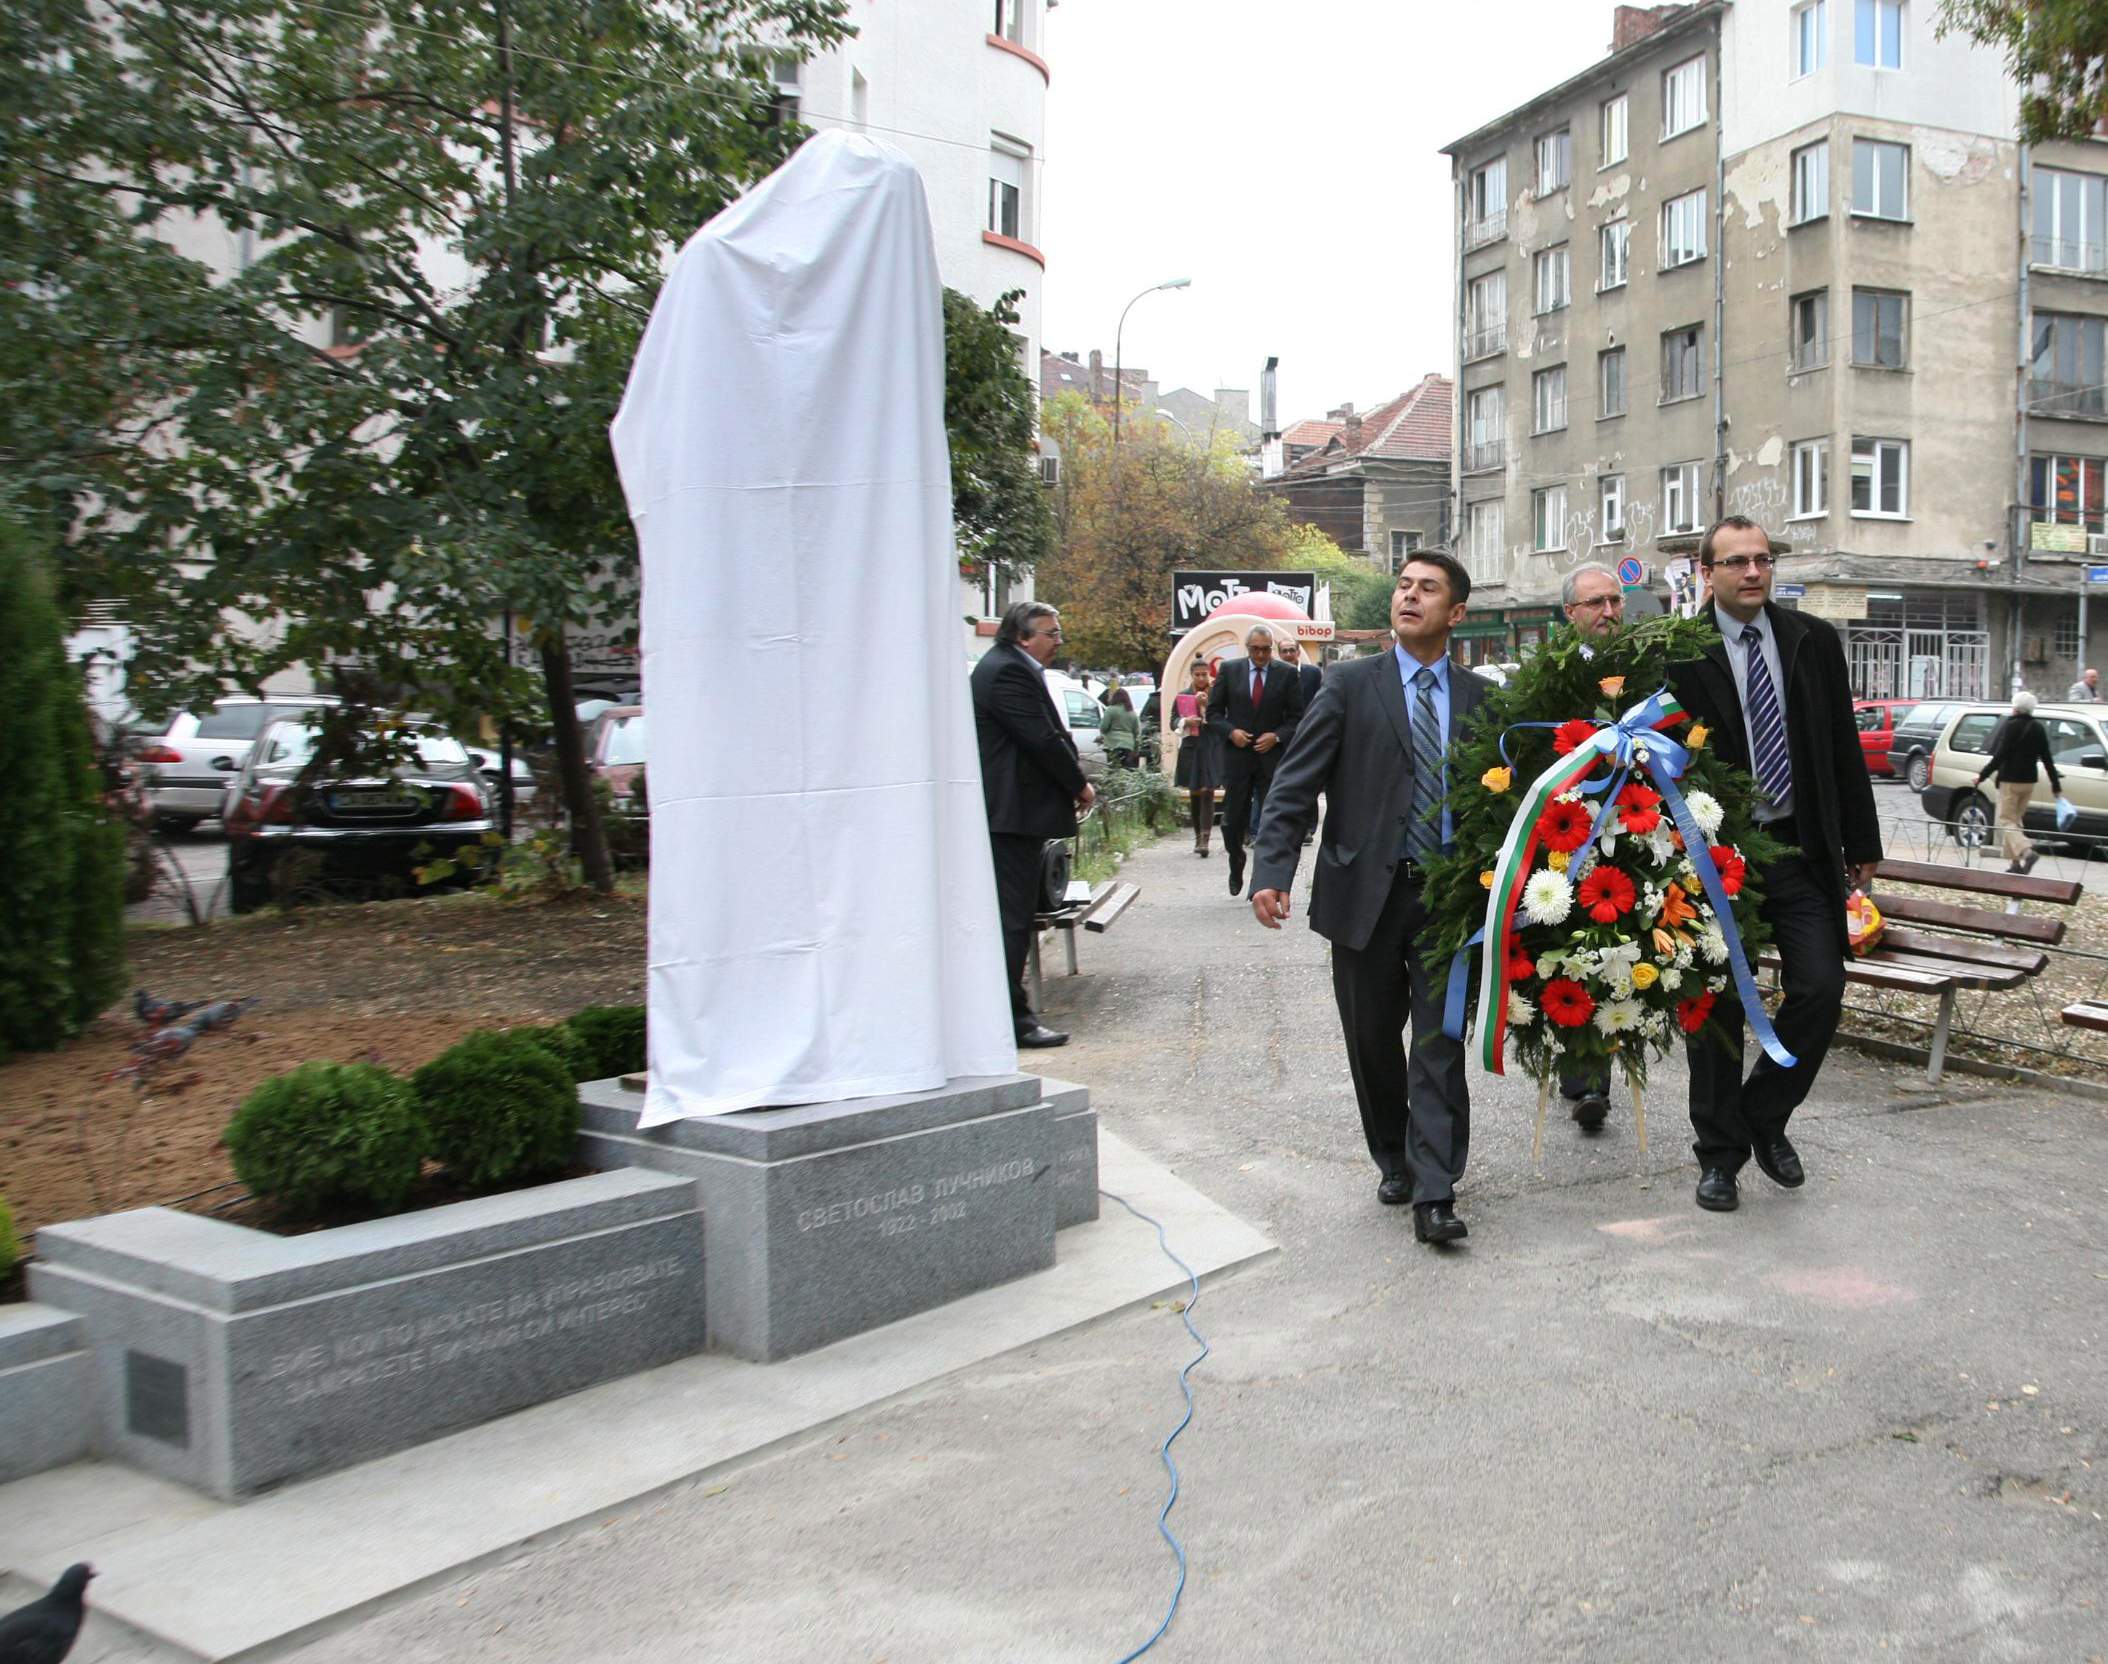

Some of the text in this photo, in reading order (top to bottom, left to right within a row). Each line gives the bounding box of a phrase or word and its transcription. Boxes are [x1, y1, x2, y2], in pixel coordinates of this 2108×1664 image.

[1297, 626, 1332, 638] bibop
[797, 1185, 924, 1232] СВЕТОСЛАВ
[934, 1157, 1034, 1199] ЛУЧНИКОВ
